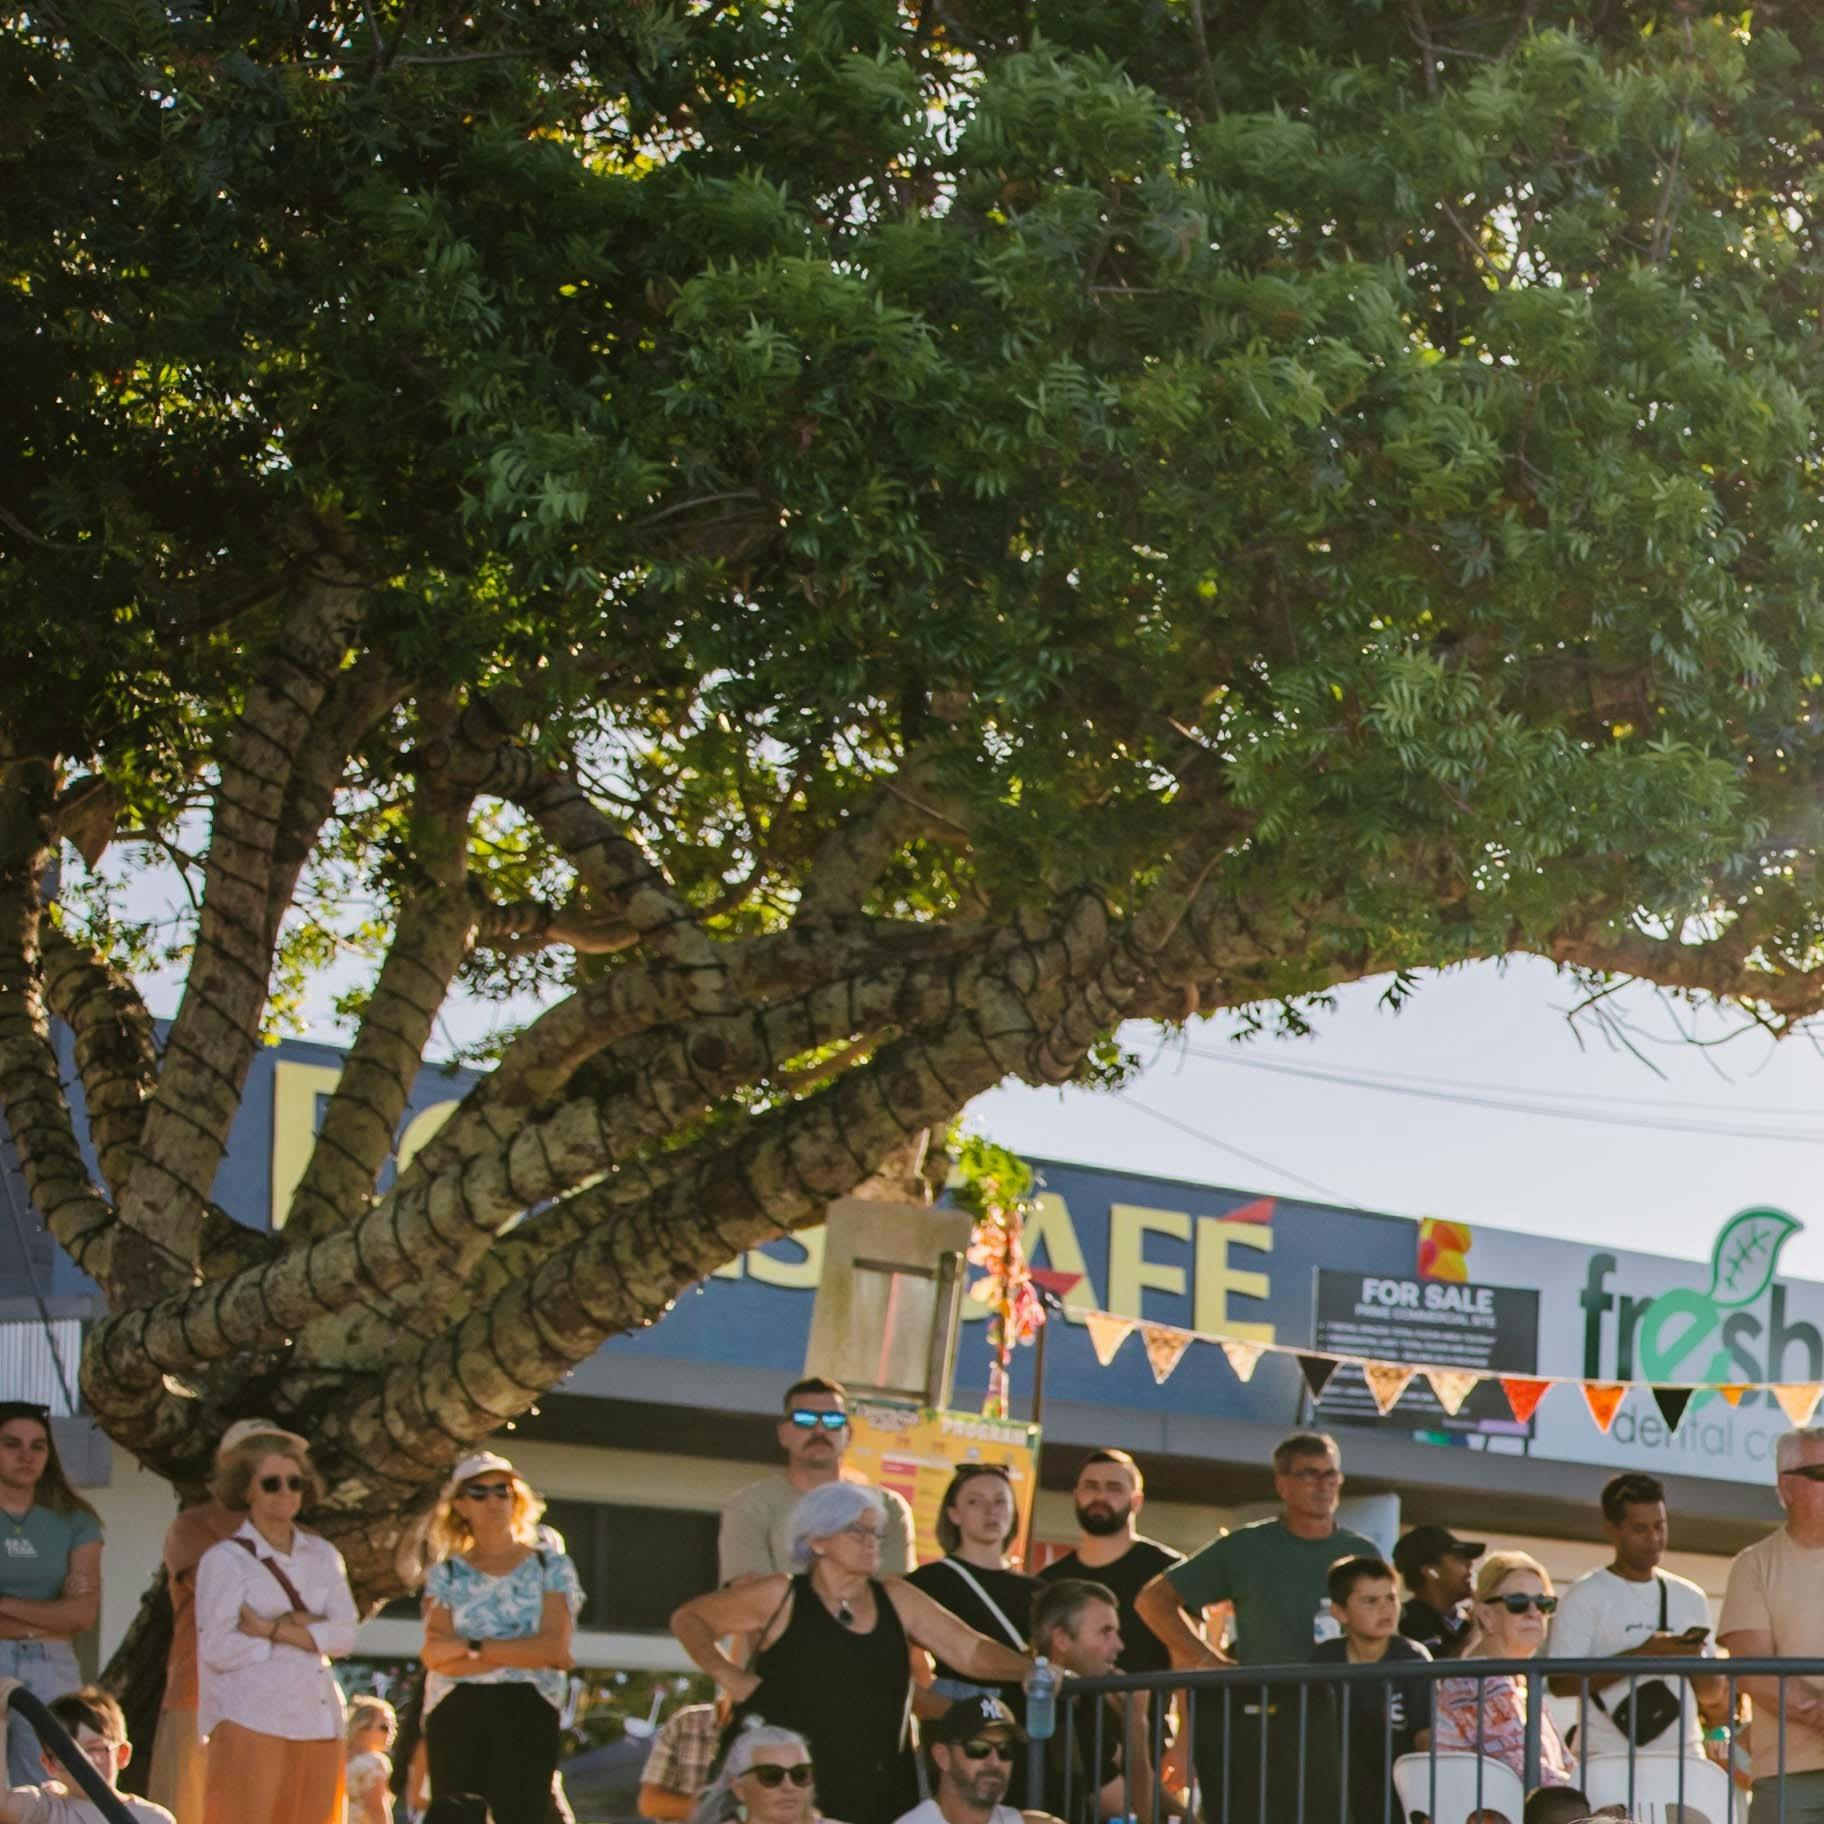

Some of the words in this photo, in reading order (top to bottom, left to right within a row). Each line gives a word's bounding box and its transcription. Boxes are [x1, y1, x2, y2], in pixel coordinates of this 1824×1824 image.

[1362, 1278, 1419, 1307] FOR
[1424, 1283, 1495, 1314] SALE
[1580, 1253, 1824, 1415] fresh
